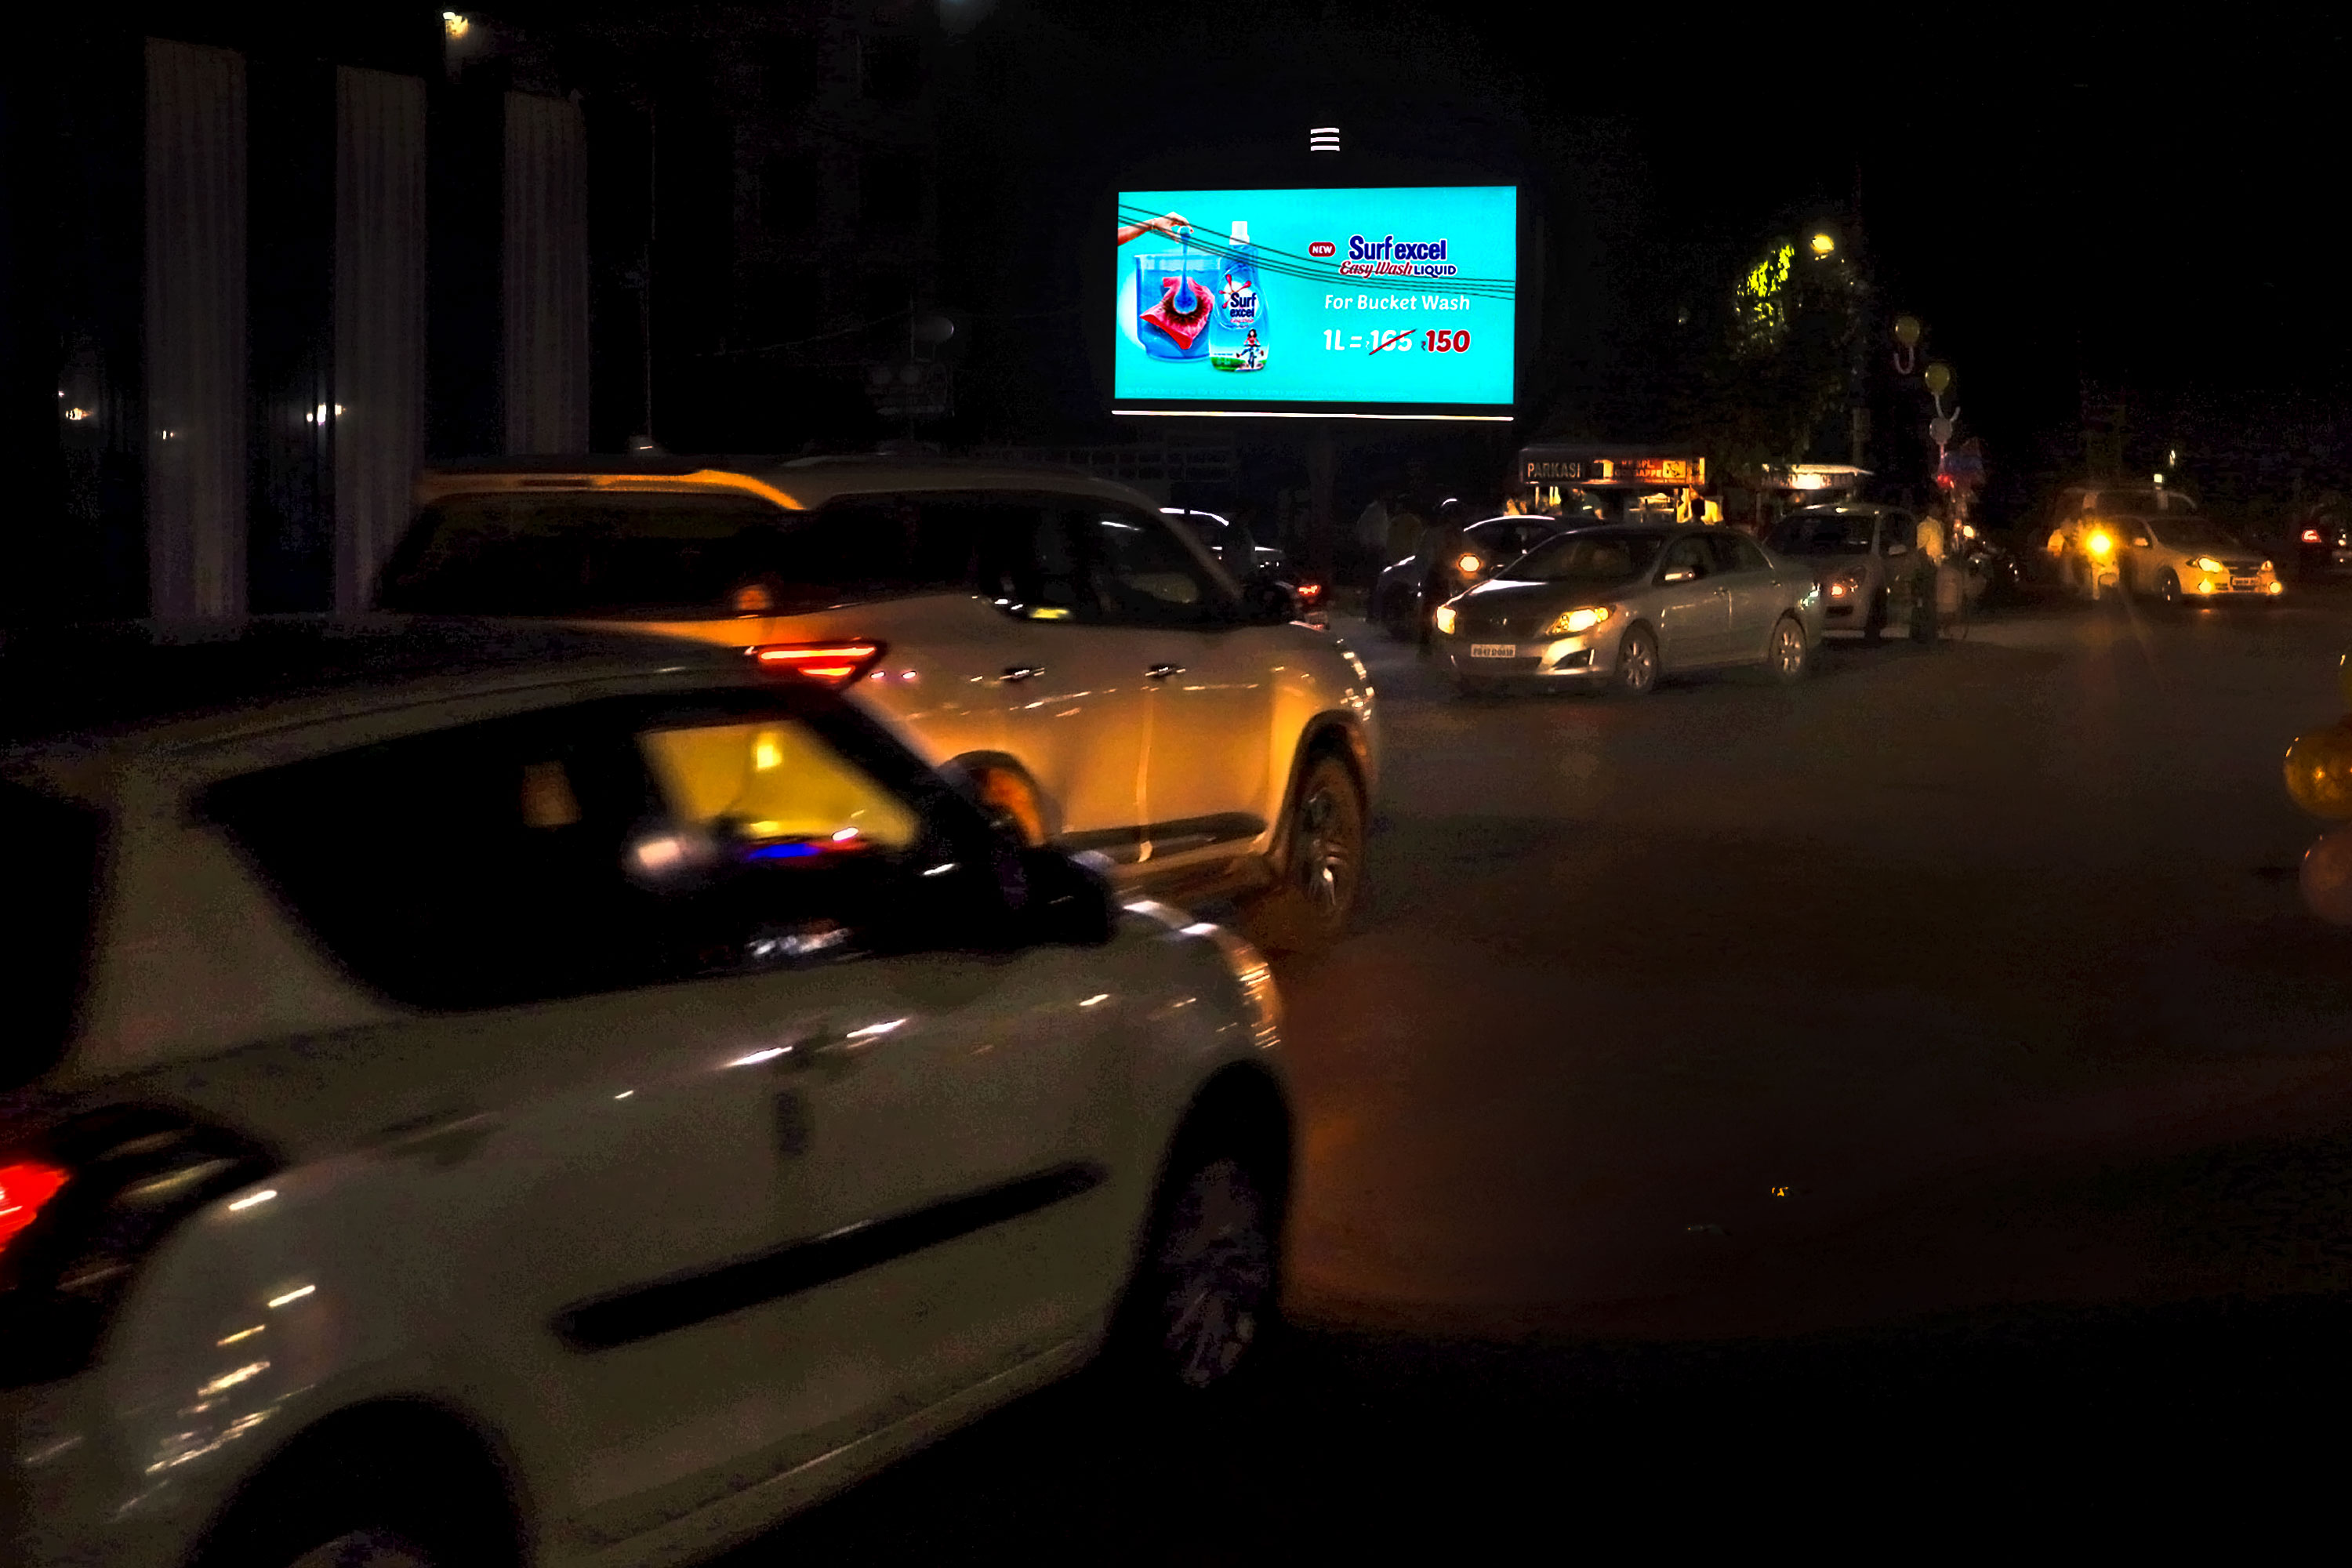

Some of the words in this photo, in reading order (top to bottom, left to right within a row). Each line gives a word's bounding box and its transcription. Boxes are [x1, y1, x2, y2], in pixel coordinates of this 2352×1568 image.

[1312, 245, 1333, 254] NEW
[1349, 235, 1392, 260] Surf
[1394, 239, 1446, 260] excel
[1340, 261, 1374, 278] Easy
[1375, 261, 1413, 275] Wash
[1414, 264, 1457, 278] LIQUID
[1230, 292, 1257, 307] Surf
[1325, 294, 1353, 309] For
[1358, 294, 1417, 310] Bucket
[1422, 295, 1470, 310] Wash
[1230, 308, 1254, 318] excel
